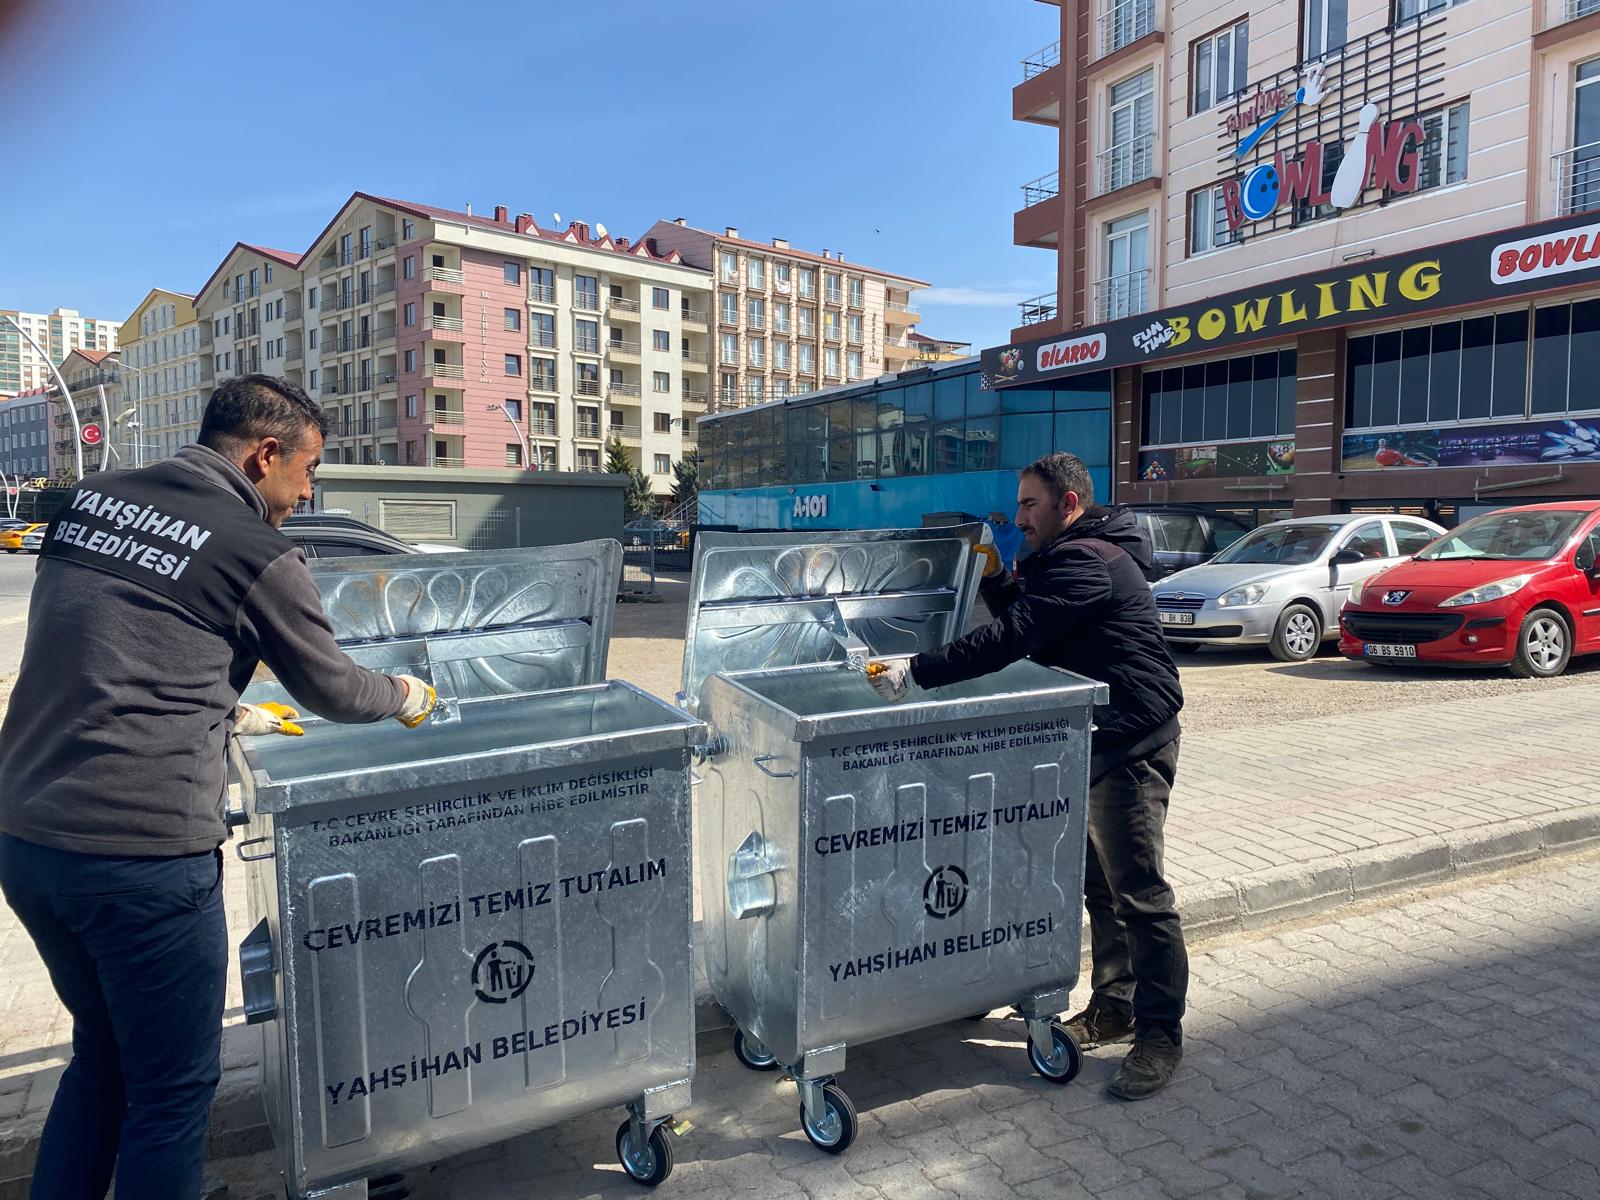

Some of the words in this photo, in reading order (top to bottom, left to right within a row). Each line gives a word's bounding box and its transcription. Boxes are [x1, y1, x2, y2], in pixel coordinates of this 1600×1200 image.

[1226, 106, 1256, 138] FUN
[1253, 88, 1287, 116] TIME
[1165, 259, 1443, 349] BOWLING
[1132, 321, 1164, 347] FUN
[1140, 326, 1175, 354] TIME
[70, 488, 212, 551] YAHŞİHAN
[53, 520, 191, 581] BELEDİYESİ
[1368, 645, 1378, 655] 06
[1381, 645, 1391, 656] BS
[1393, 645, 1415, 656] 5910
[908, 745, 979, 761] TARAFINDAN
[960, 731, 973, 741] VE
[498, 788, 518, 801] VE
[930, 810, 987, 837] TEMİZ
[993, 797, 1070, 826] TUTALIM
[469, 881, 552, 917] TEMİZ
[559, 857, 666, 898] TUTALIM
[944, 912, 1052, 956] BELEDİYESİ
[492, 996, 646, 1059] BELEDİYESİ
